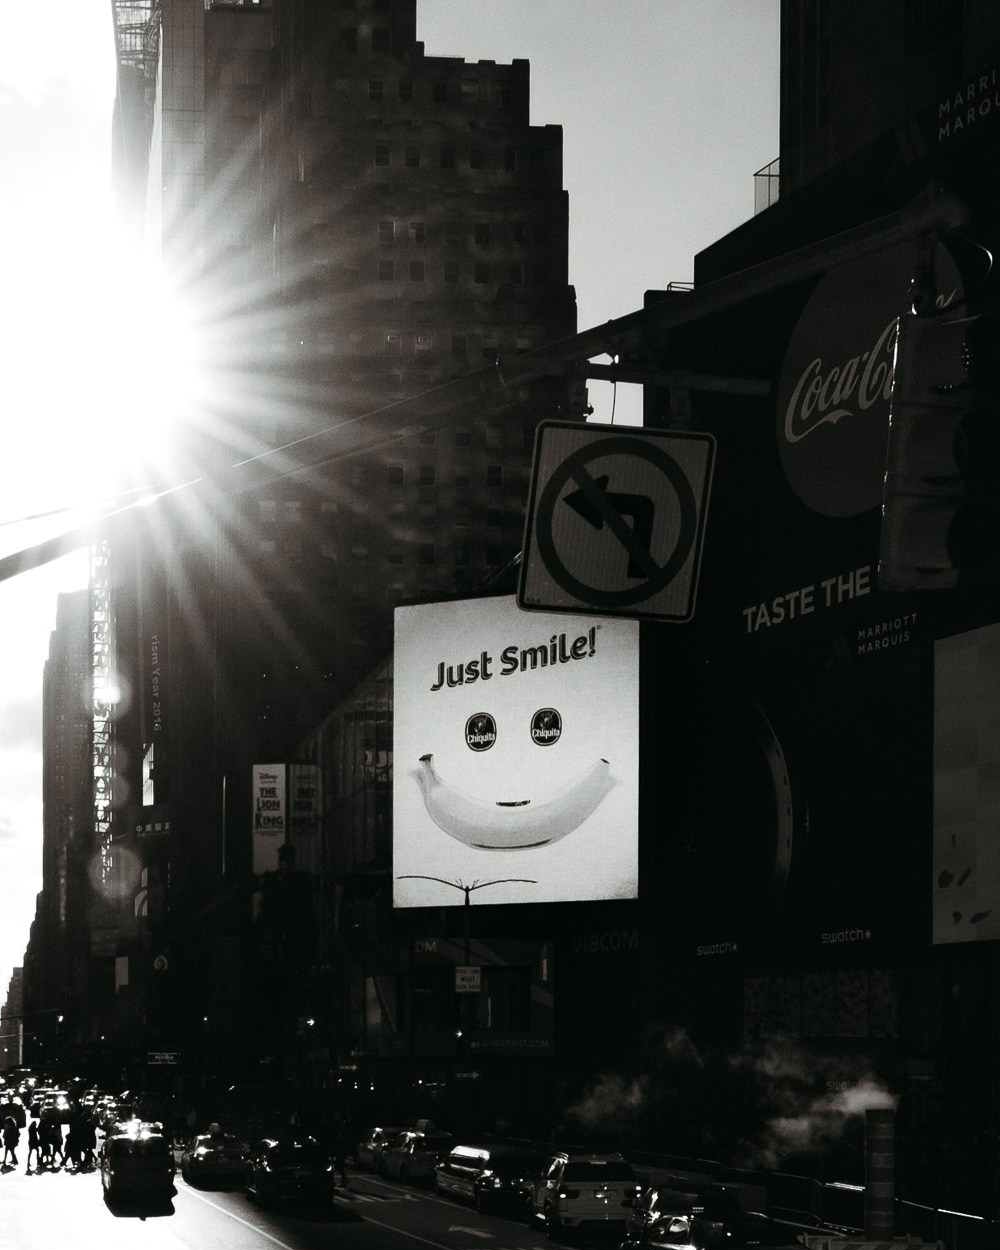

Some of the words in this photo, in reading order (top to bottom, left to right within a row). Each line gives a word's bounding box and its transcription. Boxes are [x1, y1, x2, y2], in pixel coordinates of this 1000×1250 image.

[742, 585, 815, 634] TASTE
[821, 564, 871, 607] THE
[857, 612, 918, 641] MARRIOTT
[857, 630, 911, 656] MARQUIS
[430, 651, 494, 692] Just
[500, 626, 597, 676] Smile!
[152, 667, 161, 699] Year
[152, 700, 163, 732] 2016
[467, 731, 496, 745] Chiquita
[532, 727, 561, 740] Chiquita
[260, 787, 277, 798] THE
[257, 797, 280, 812] LION
[255, 812, 283, 829] KING
[821, 927, 864, 944] swatch
[696, 942, 732, 956] swatch
